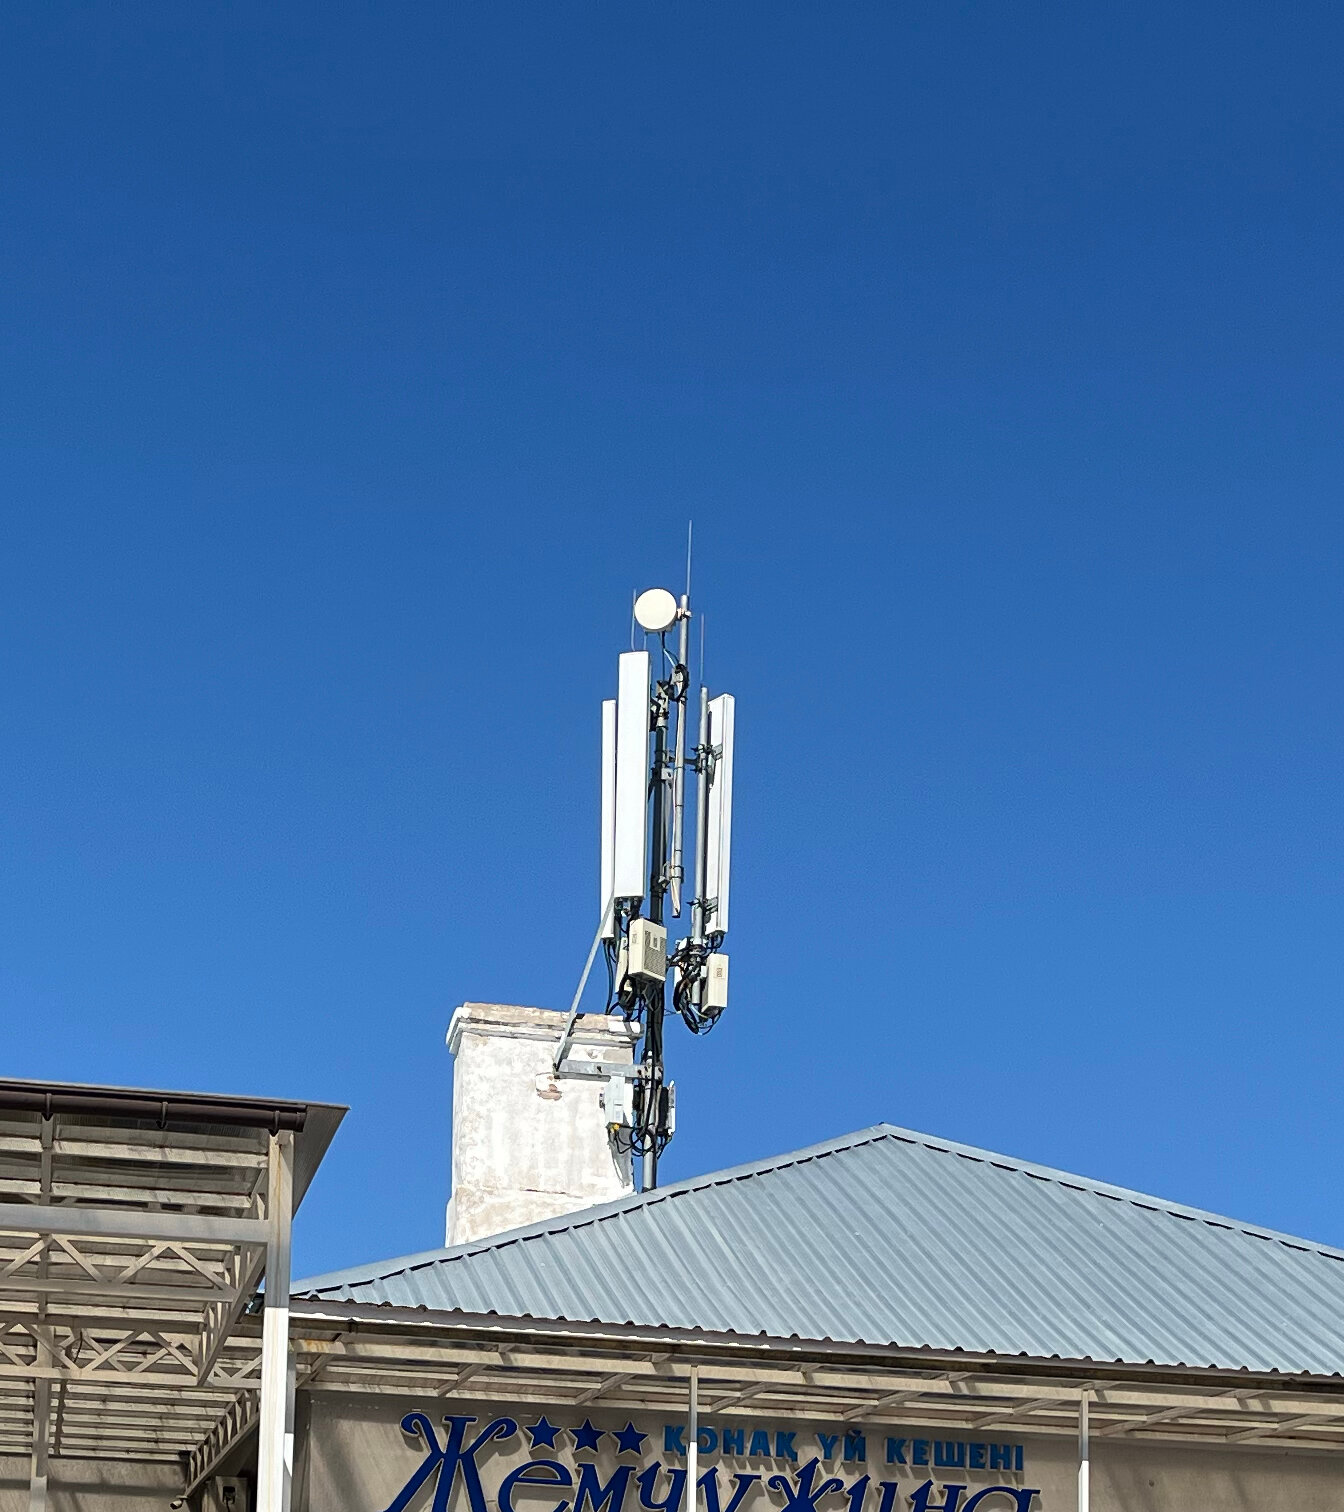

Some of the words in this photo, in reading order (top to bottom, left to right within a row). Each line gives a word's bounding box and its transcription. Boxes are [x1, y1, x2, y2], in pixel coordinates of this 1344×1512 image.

[664, 1425, 798, 1462] ҚОНАҚ
[816, 1429, 866, 1463] ҮЙ
[886, 1437, 1024, 1471] КЕШЕНІ
